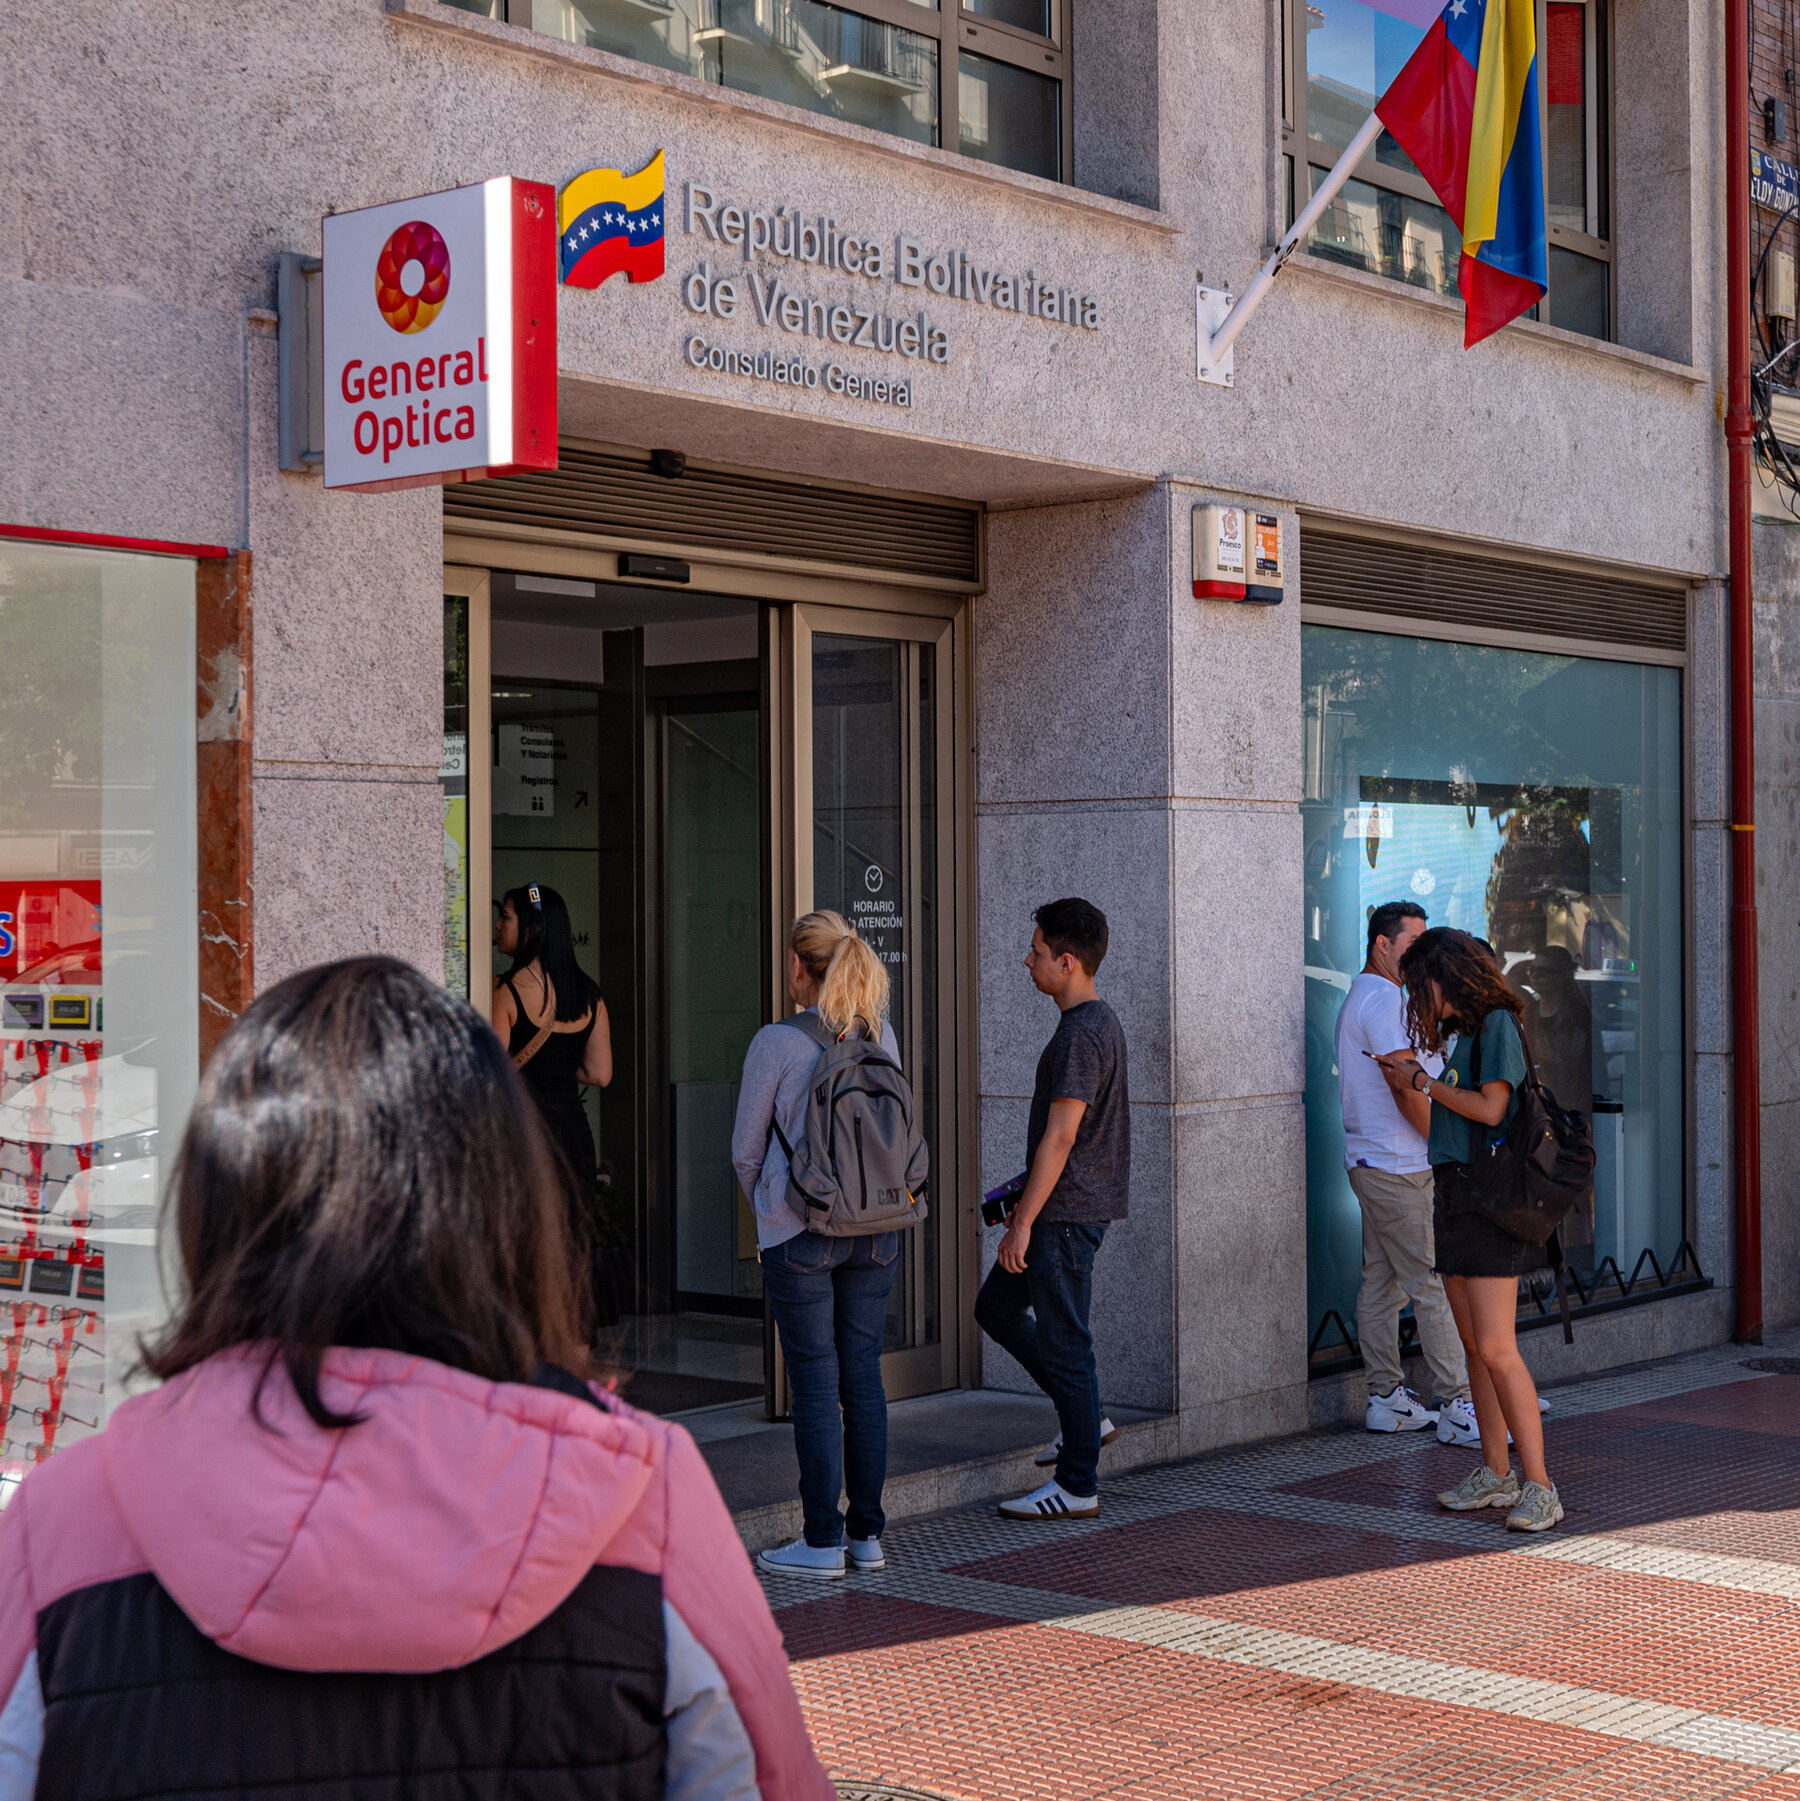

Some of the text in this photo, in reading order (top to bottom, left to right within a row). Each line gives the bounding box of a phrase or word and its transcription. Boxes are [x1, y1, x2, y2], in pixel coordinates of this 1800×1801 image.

[1776, 174, 1787, 186] DE
[683, 181, 1101, 331] República Bolivariana
[683, 262, 950, 365] de Venezuela
[341, 337, 489, 404] General
[684, 335, 912, 408] Consulado General
[354, 399, 475, 464] Optica
[1219, 537, 1242, 549] Proesco
[853, 900, 895, 912] HORARIO
[858, 913, 903, 929] ATENCIÓN
[877, 936, 884, 947] V
[877, 1188, 901, 1206] CAT
